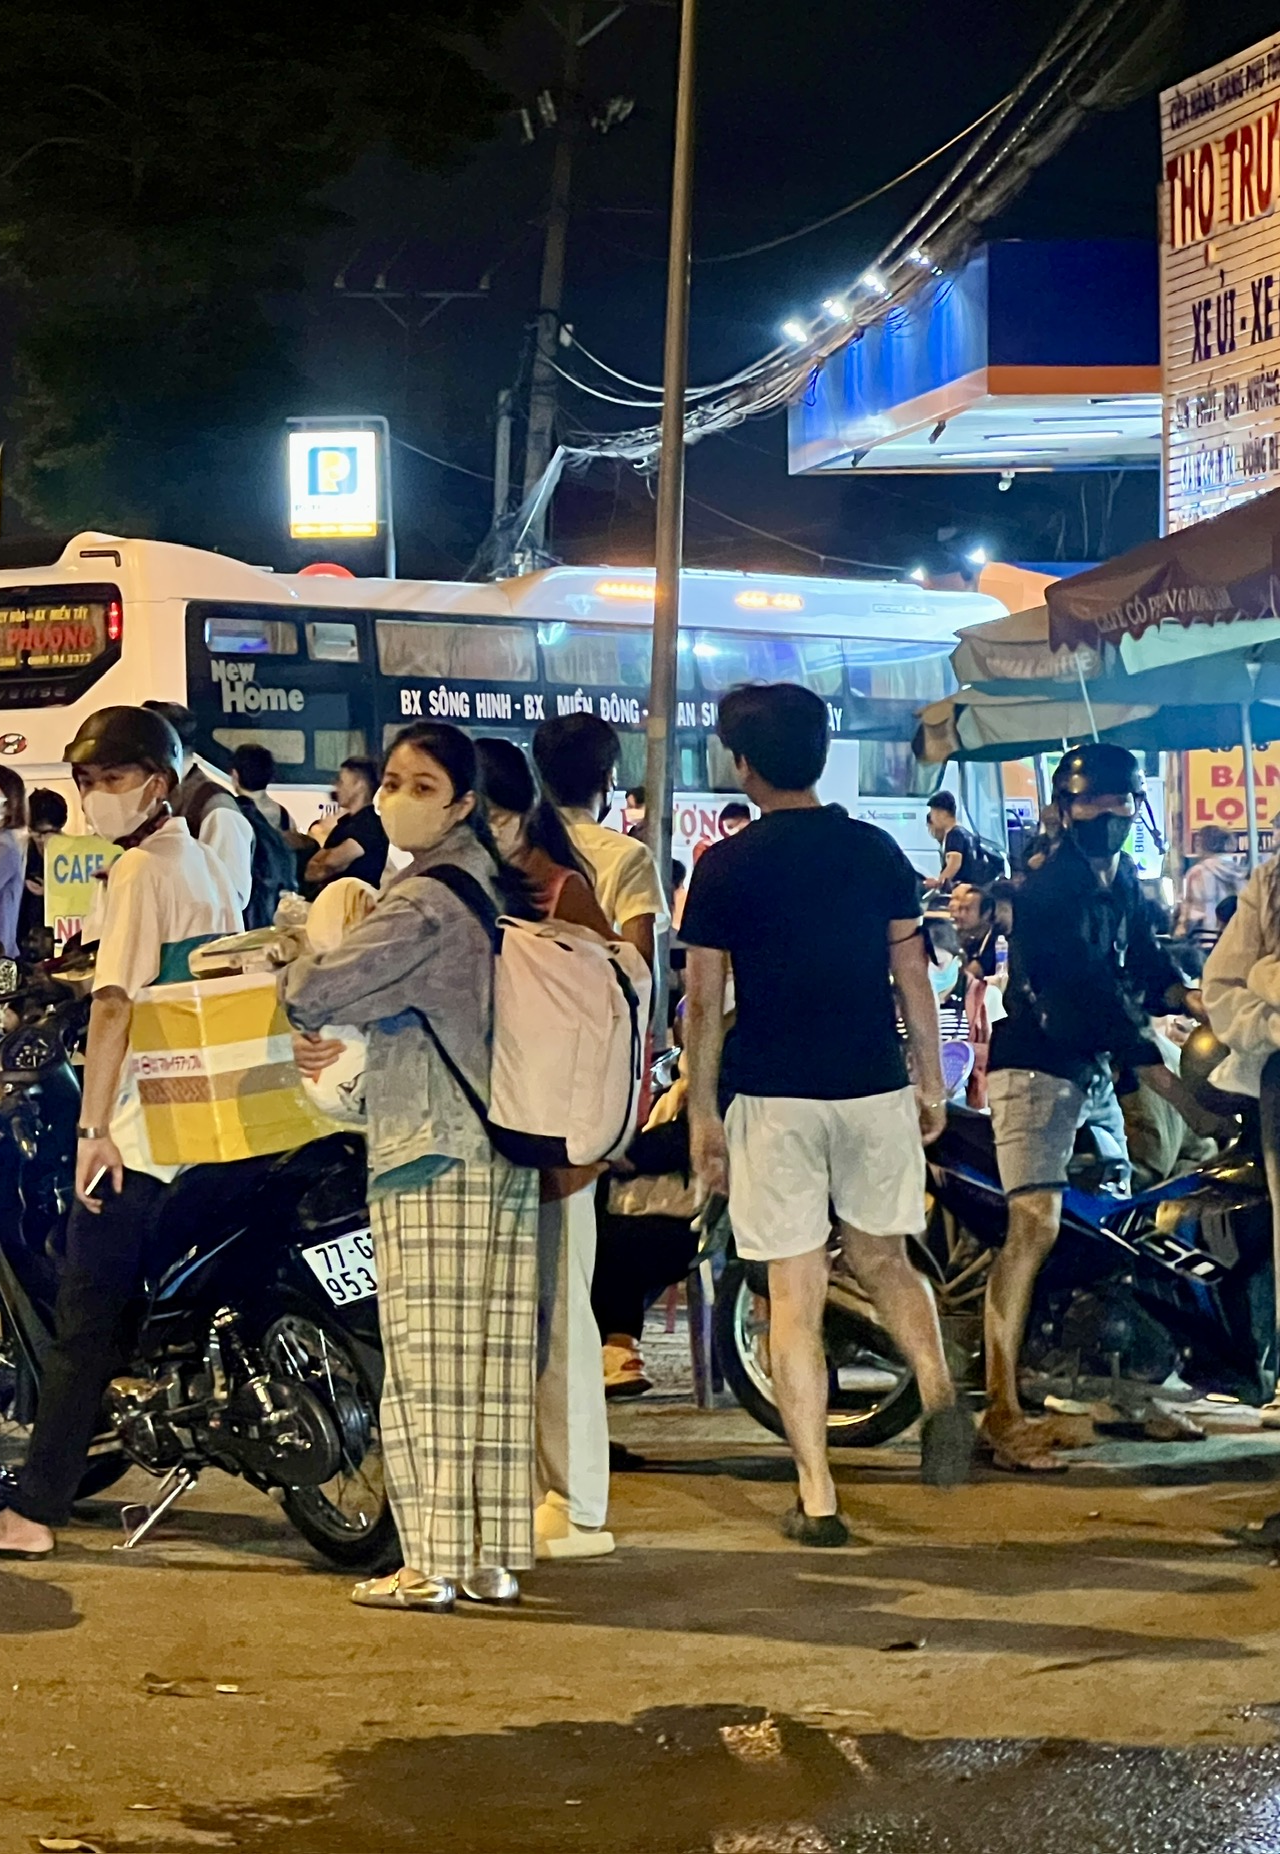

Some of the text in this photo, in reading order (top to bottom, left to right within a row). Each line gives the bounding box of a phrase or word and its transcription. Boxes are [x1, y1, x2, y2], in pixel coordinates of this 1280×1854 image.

[1191, 298, 1212, 364] XE
[1251, 274, 1273, 346] XE
[211, 659, 255, 682] New
[221, 680, 305, 713] Home
[400, 689, 422, 716] BX
[428, 685, 470, 718] SÔNG
[476, 692, 512, 719] HINH
[524, 694, 545, 720] BX
[600, 692, 640, 724] ĐÔNG
[677, 702, 696, 727] AN
